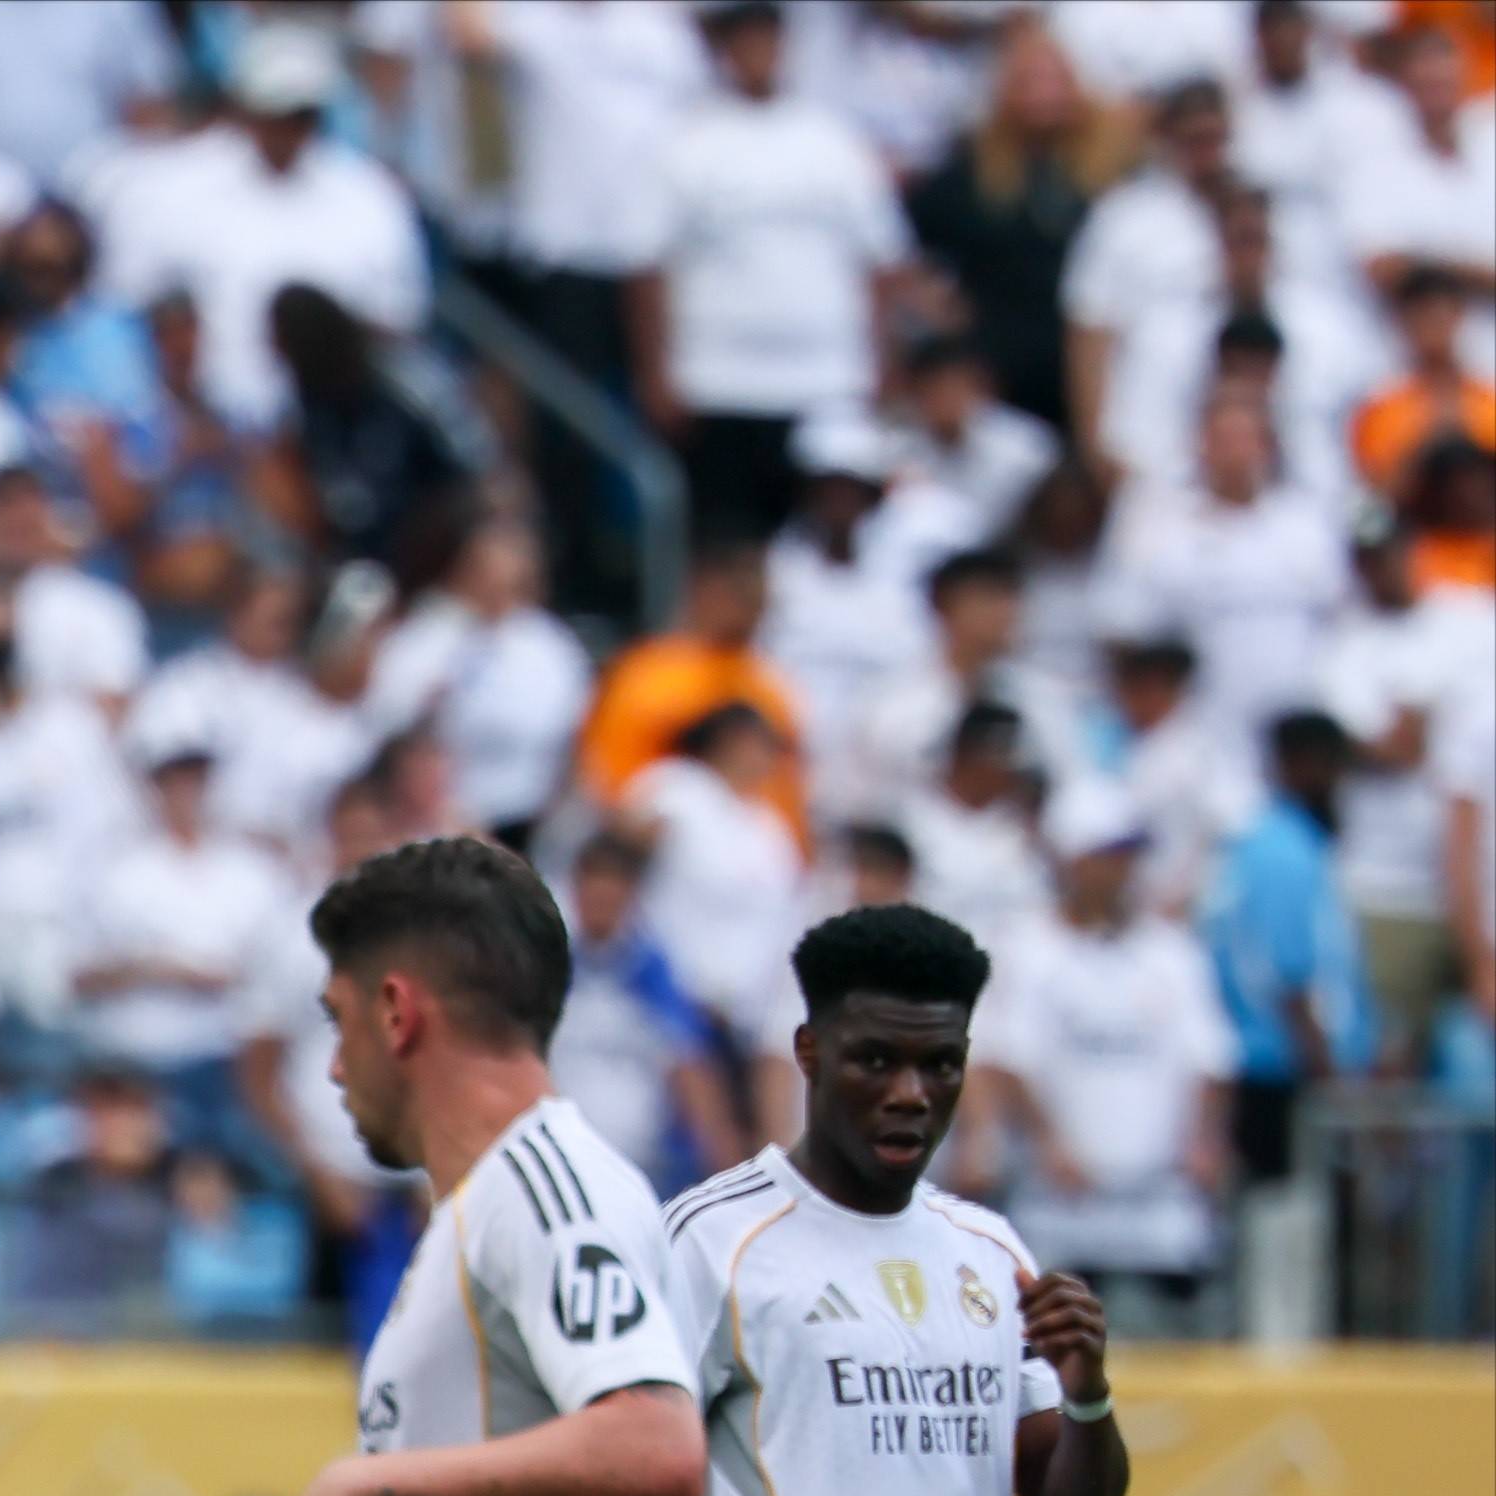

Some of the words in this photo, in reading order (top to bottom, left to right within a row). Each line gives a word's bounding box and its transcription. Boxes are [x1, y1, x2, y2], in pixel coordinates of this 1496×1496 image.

[554, 1242, 646, 1343] hp
[825, 1358, 1003, 1407] Emirates
[871, 1414, 907, 1455] FLY
